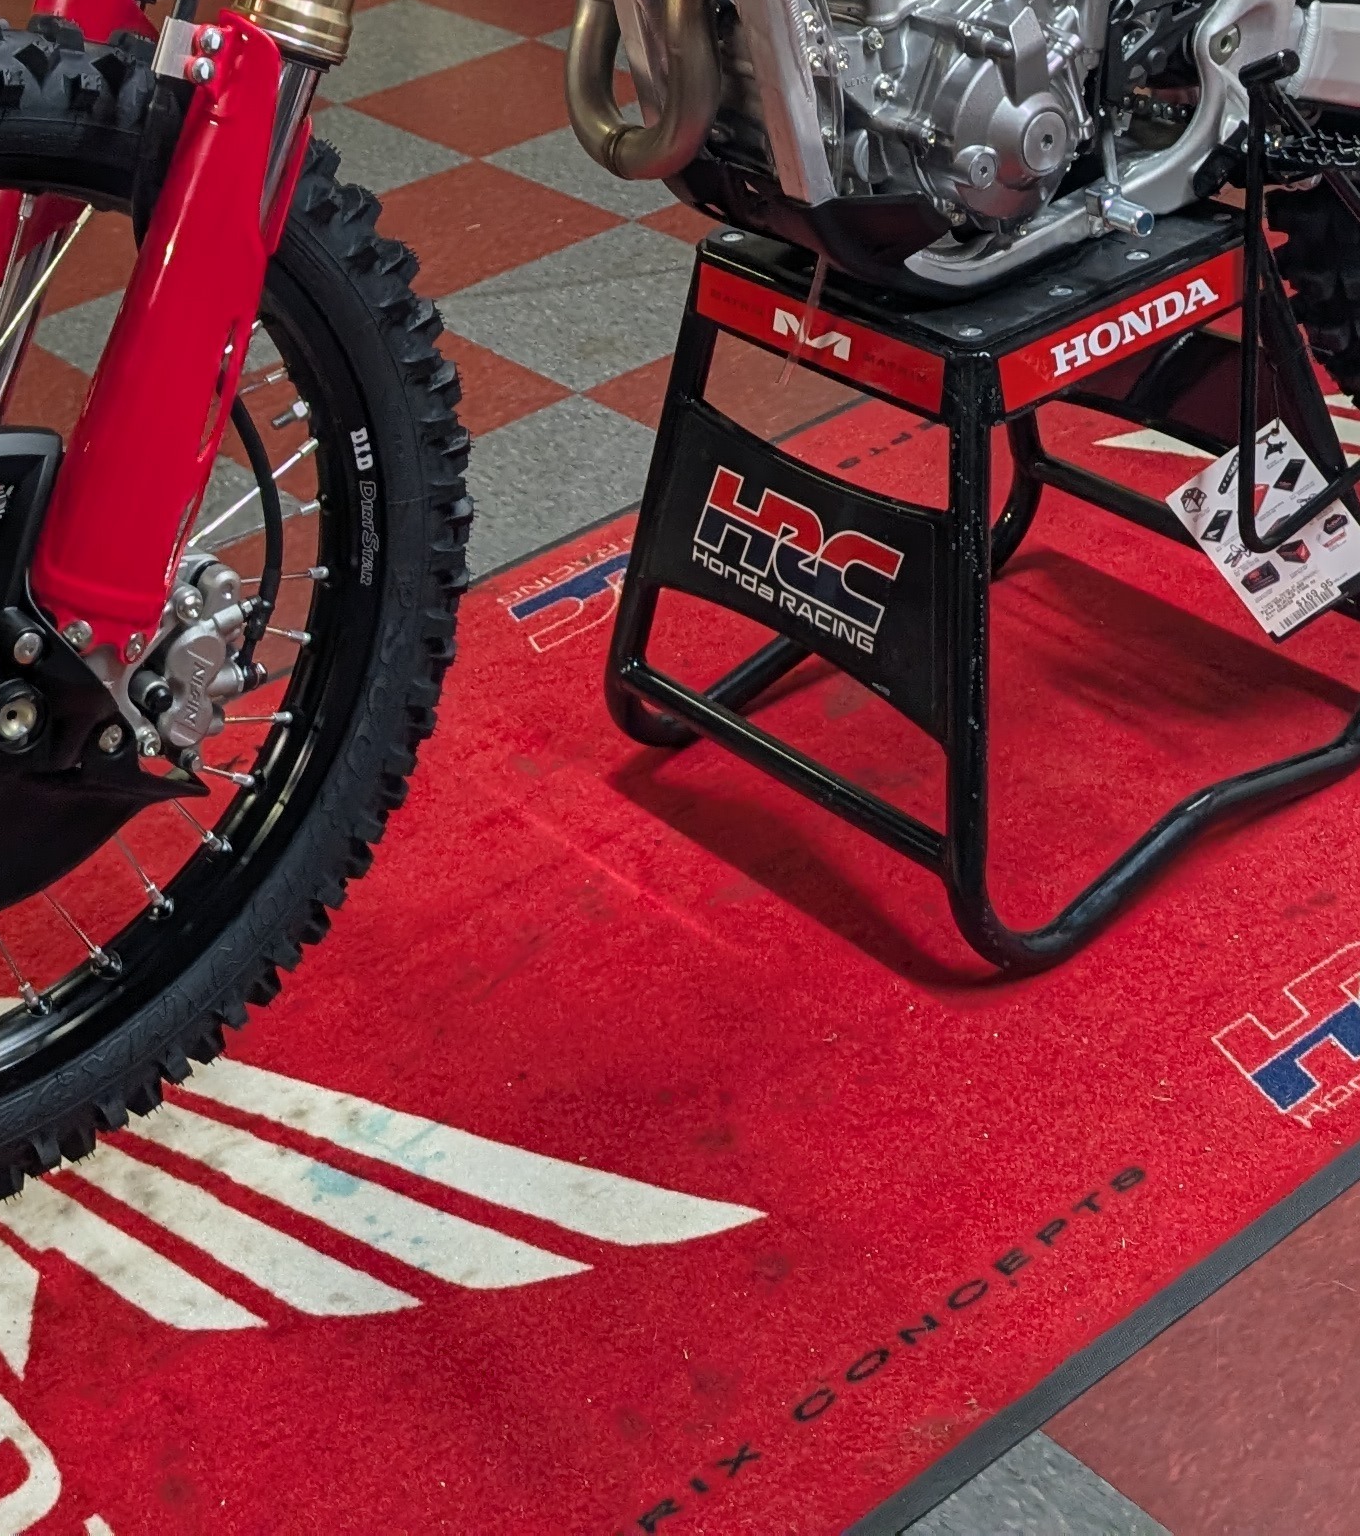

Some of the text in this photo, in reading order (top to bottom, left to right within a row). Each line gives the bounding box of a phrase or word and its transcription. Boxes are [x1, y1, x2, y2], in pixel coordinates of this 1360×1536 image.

[1050, 278, 1219, 377] HONDA
[692, 545, 774, 602] Honda
[778, 590, 875, 654] RACING
[693, 465, 905, 634] HRC
[792, 1166, 1146, 1422] CONCEPTS
